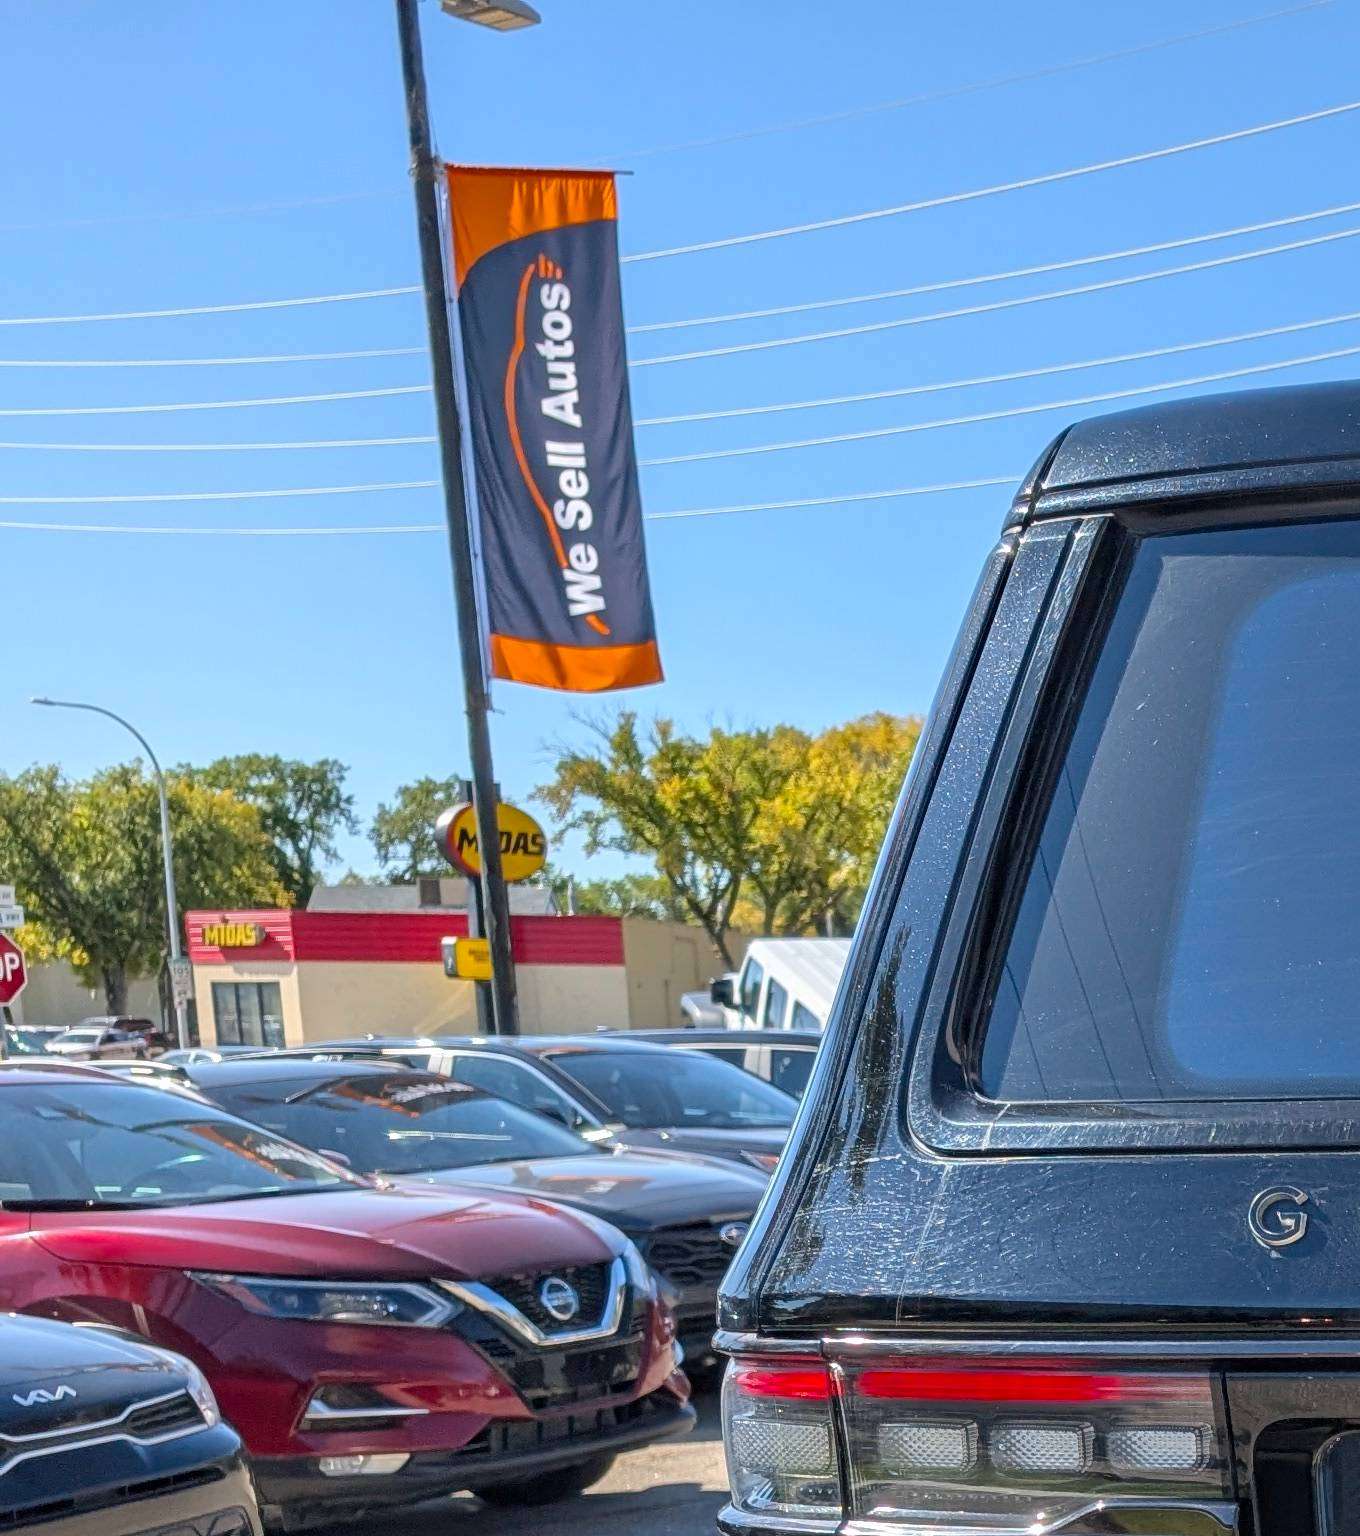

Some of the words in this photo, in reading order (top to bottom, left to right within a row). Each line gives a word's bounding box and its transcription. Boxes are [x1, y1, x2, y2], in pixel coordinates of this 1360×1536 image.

[536, 283, 582, 428] Autos
[546, 442, 593, 531] Sell
[563, 541, 606, 617] We
[457, 827, 545, 856] MDAS
[203, 923, 256, 948] MIDAS
